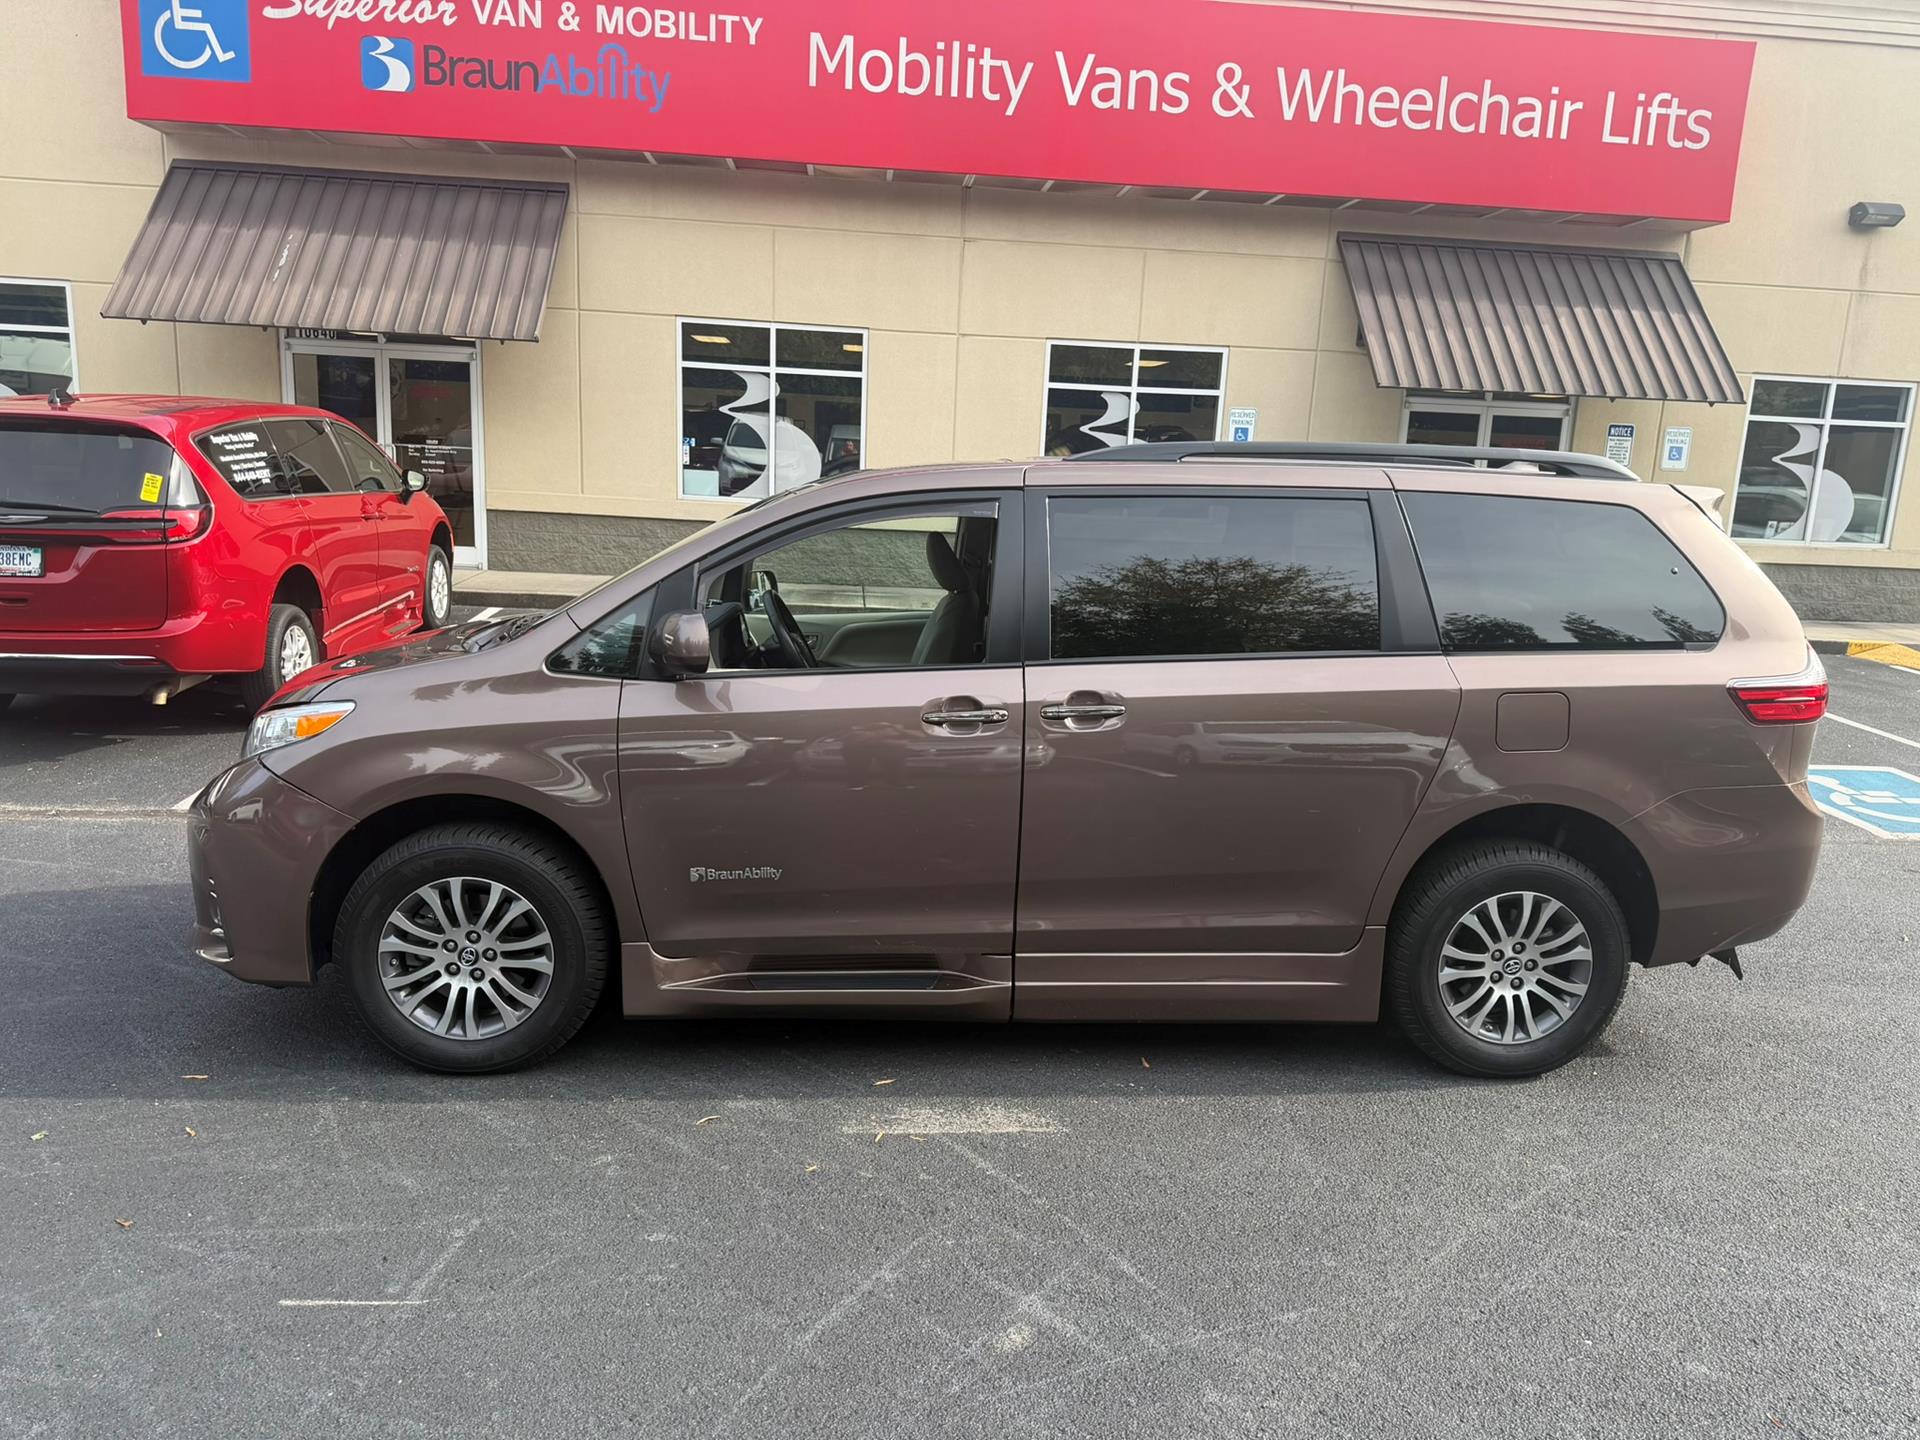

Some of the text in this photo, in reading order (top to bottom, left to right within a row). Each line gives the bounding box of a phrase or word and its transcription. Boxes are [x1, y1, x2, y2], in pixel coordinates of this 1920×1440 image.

[472, 0, 542, 29] VAN
[557, 1, 581, 32] &
[596, 4, 764, 46] MOBILITY
[422, 43, 672, 113] BraunAbility
[806, 31, 1713, 150] Mobility Vans & Wheelchair Lifts
[1610, 427, 1633, 437] NOTICE
[707, 867, 783, 881] BraunAbility
